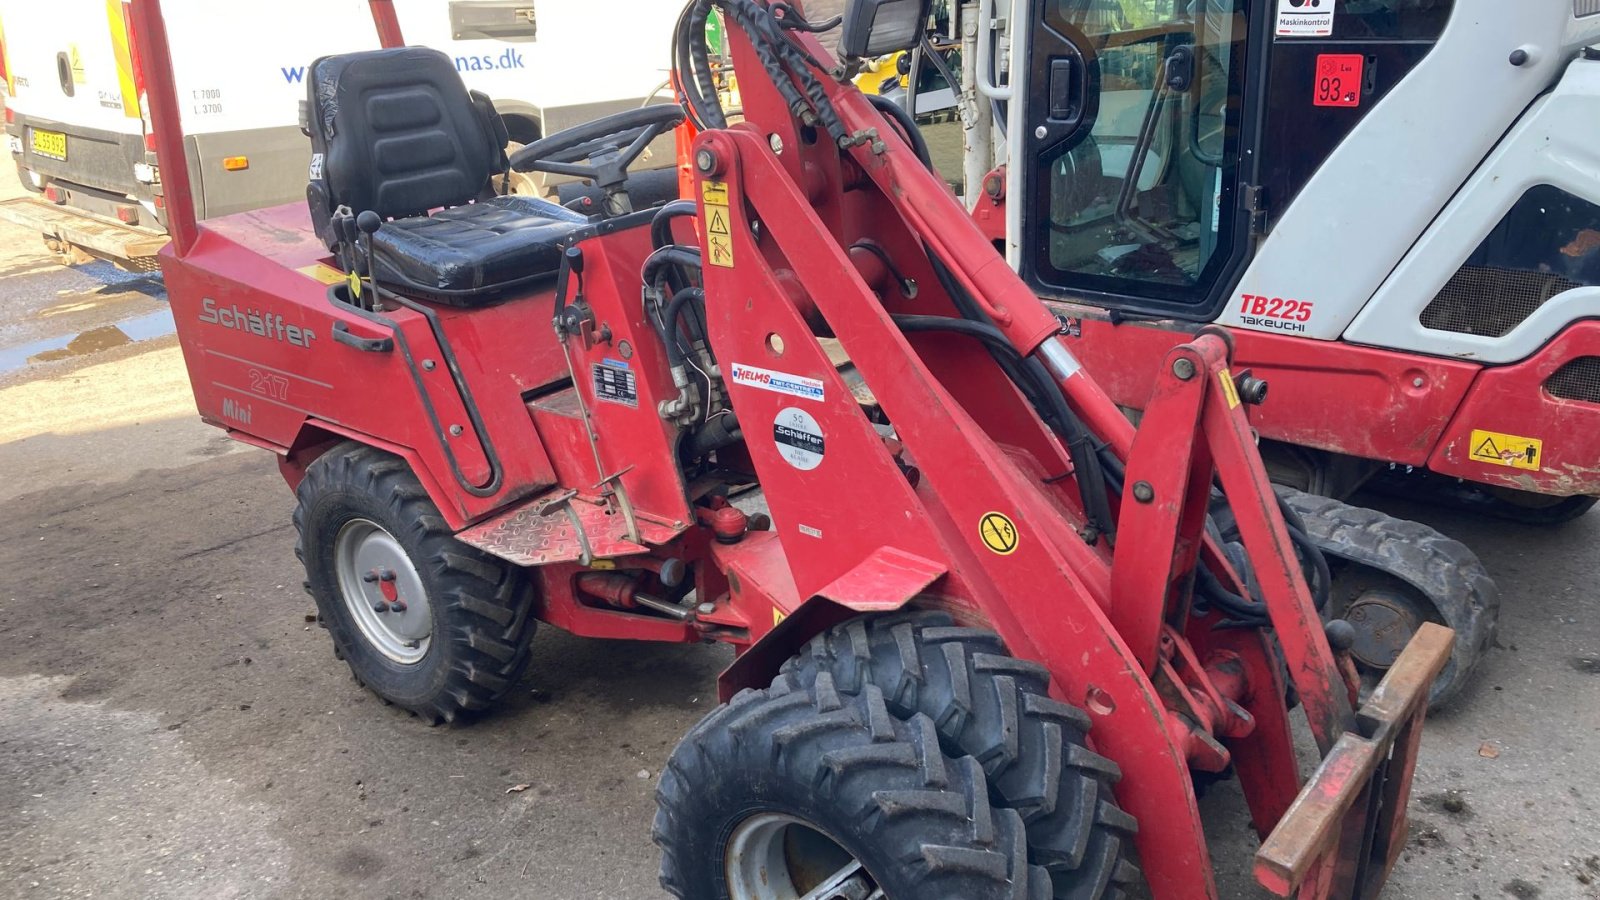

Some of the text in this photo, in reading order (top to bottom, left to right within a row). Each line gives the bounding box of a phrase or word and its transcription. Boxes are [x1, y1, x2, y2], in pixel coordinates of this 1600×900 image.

[201, 89, 221, 99] 7000
[1319, 77, 1342, 101] 93
[202, 103, 223, 114] 3700
[1241, 294, 1313, 321] TB225
[199, 297, 317, 349] Schäffer
[248, 368, 289, 400] 217
[737, 367, 771, 385] HELMS
[222, 398, 252, 425] Mini
[792, 413, 804, 424] 50
[775, 426, 823, 445] Schäffer
